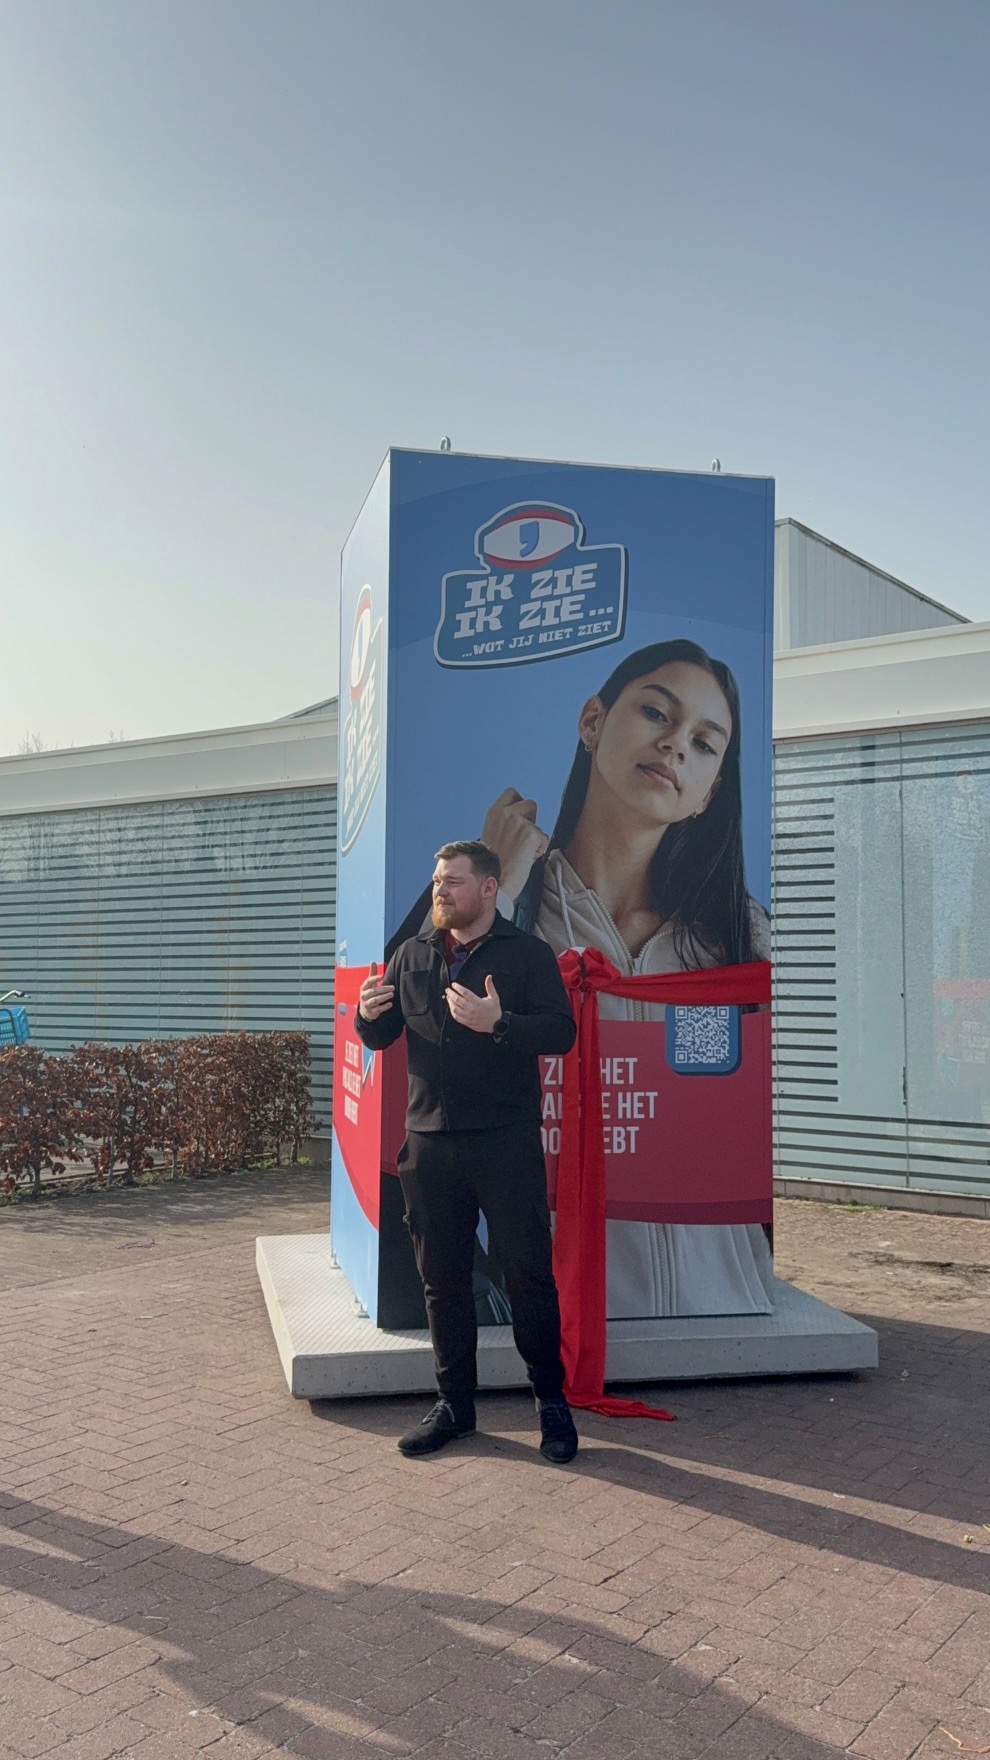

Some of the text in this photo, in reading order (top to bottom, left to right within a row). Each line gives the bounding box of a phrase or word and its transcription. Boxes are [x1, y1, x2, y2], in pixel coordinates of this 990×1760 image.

[464, 562, 598, 608] IK ZIE
[453, 593, 614, 639] IK ZIE...
[508, 634, 535, 649] JIJ
[538, 628, 573, 644] NIET
[577, 620, 612, 636] ZIET
[600, 1057, 638, 1085] HET
[617, 1091, 658, 1119] HET
